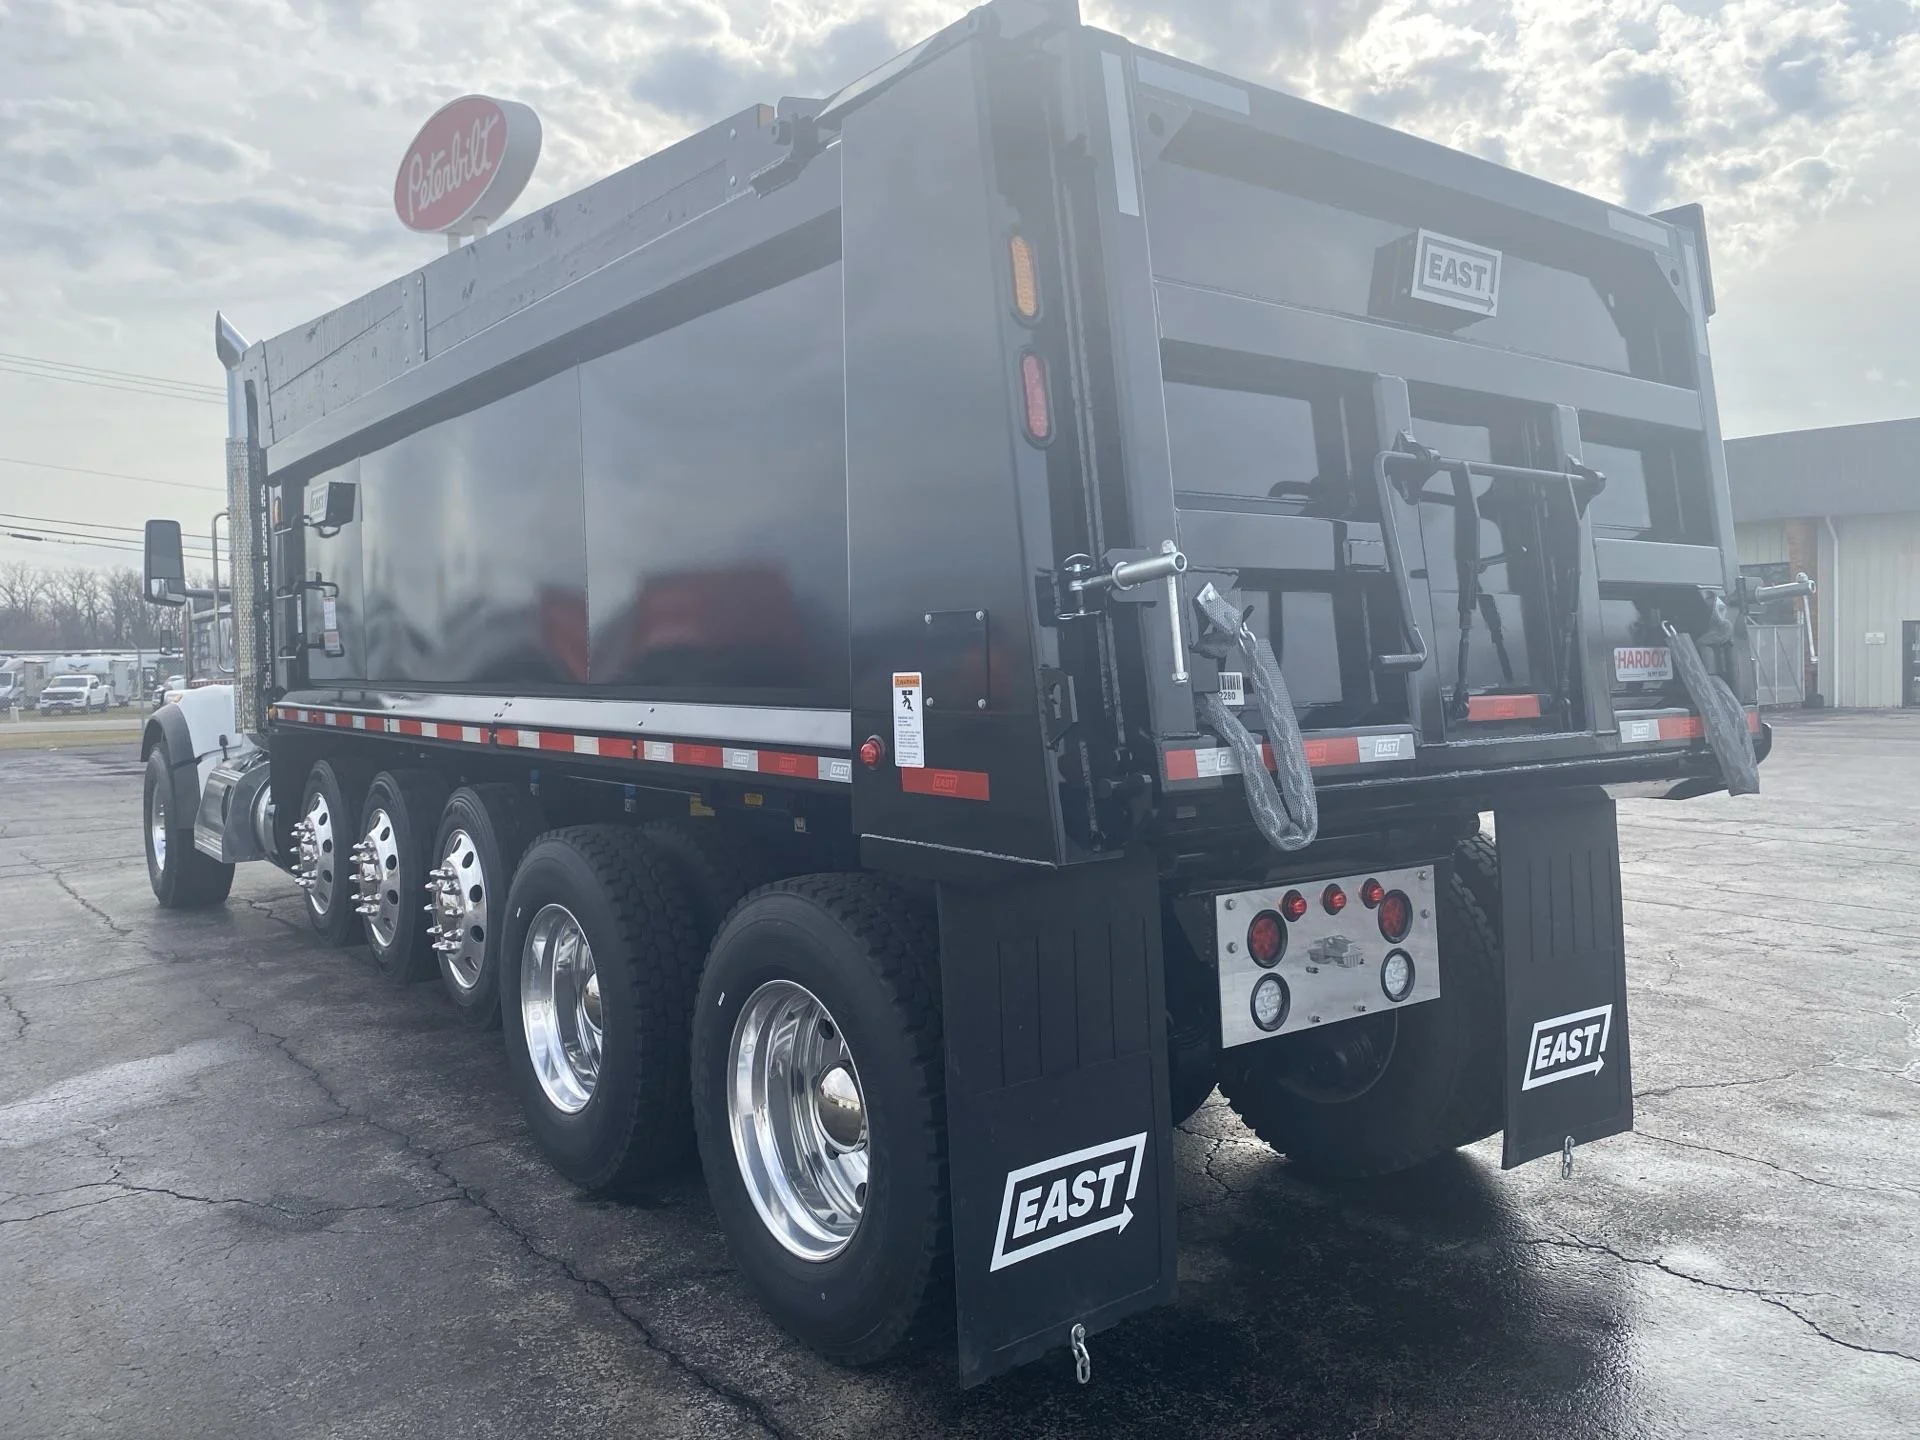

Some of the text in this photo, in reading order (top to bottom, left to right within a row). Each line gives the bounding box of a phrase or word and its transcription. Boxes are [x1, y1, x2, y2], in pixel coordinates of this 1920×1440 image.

[408, 114, 499, 222] Peterbilt
[1428, 252, 1488, 292] EAST
[1617, 650, 1667, 669] HARDOX
[1378, 743, 1397, 753] EAST
[832, 766, 848, 776] EAST
[1535, 1023, 1601, 1071] EAST
[1012, 1160, 1126, 1240] EAST
